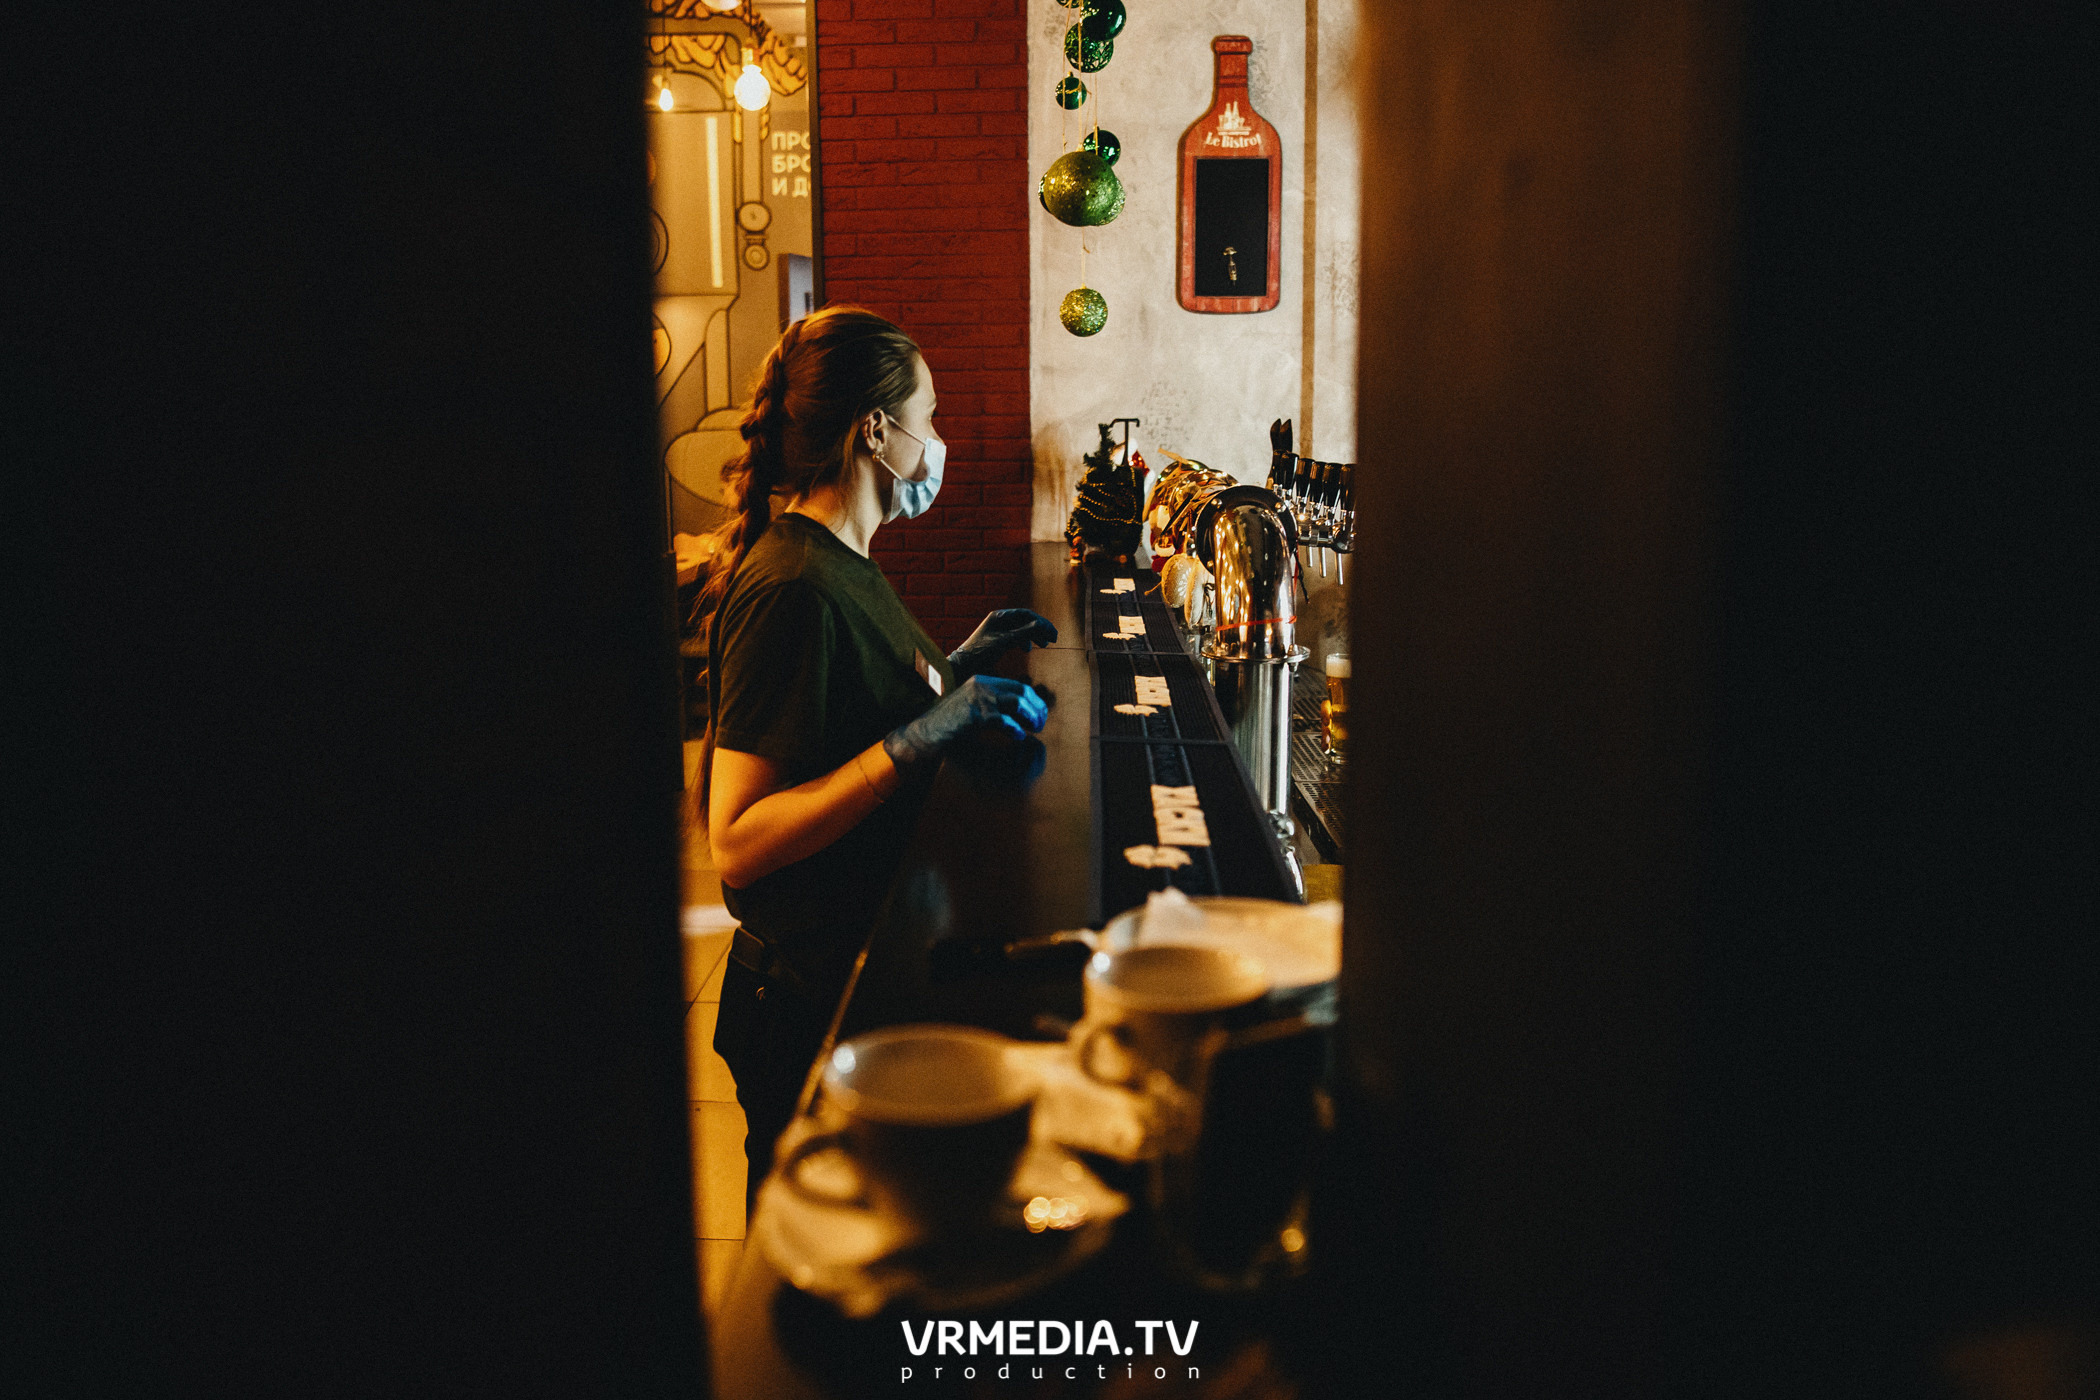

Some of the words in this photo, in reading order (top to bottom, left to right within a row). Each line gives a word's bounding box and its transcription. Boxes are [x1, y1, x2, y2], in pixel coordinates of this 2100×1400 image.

[1205, 131, 1220, 147] Le
[1221, 133, 1262, 149] Bistrot
[792, 176, 812, 198] Д
